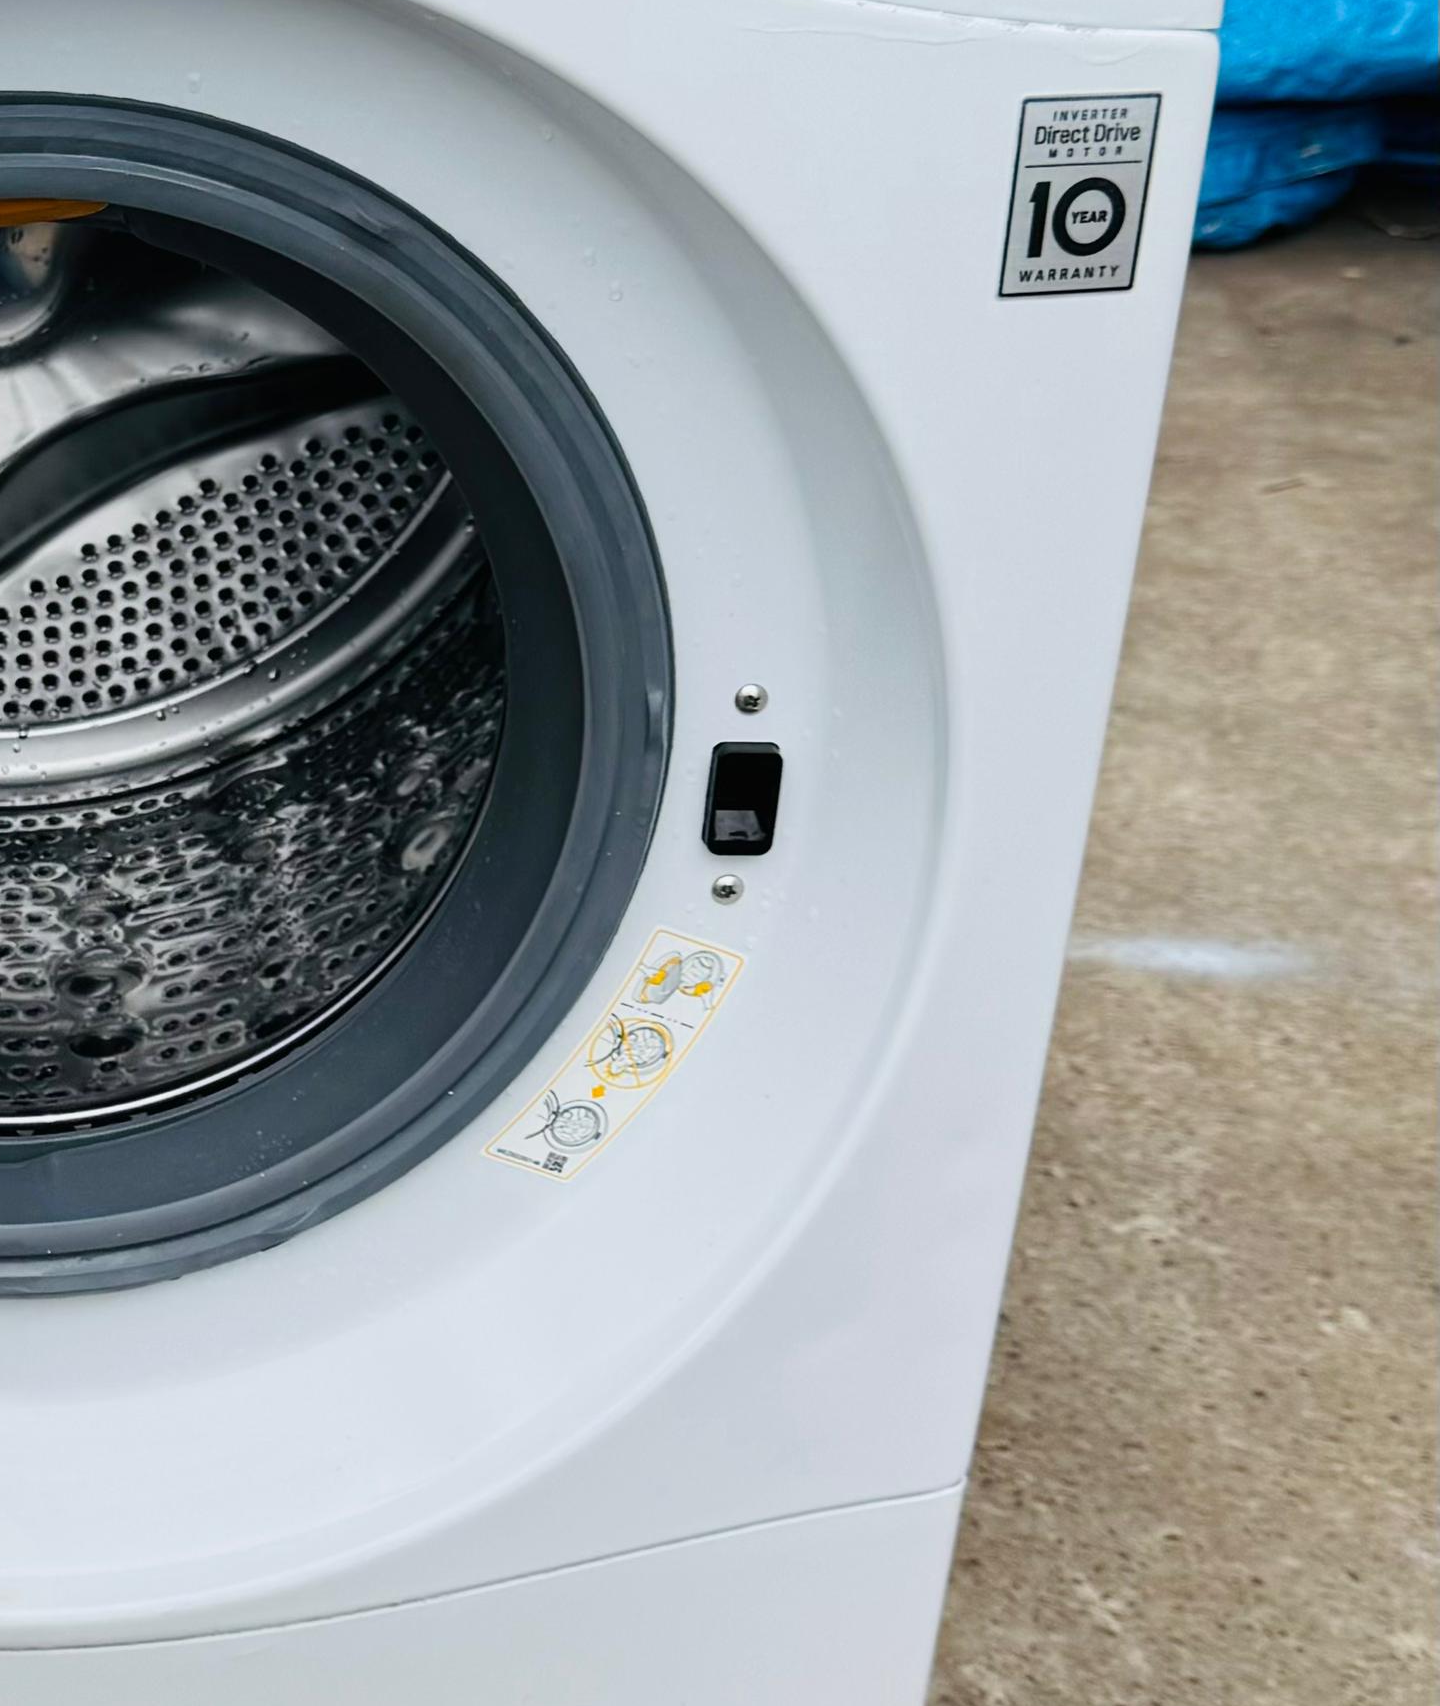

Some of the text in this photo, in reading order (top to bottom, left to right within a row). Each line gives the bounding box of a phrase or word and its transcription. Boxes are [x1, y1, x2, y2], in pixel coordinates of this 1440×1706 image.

[1053, 108, 1128, 121] INVERTER
[1034, 124, 1141, 145] Direct Drive
[1027, 176, 1126, 258] 10
[1071, 210, 1108, 224] YEAR
[1019, 265, 1119, 282] WARRANTY
